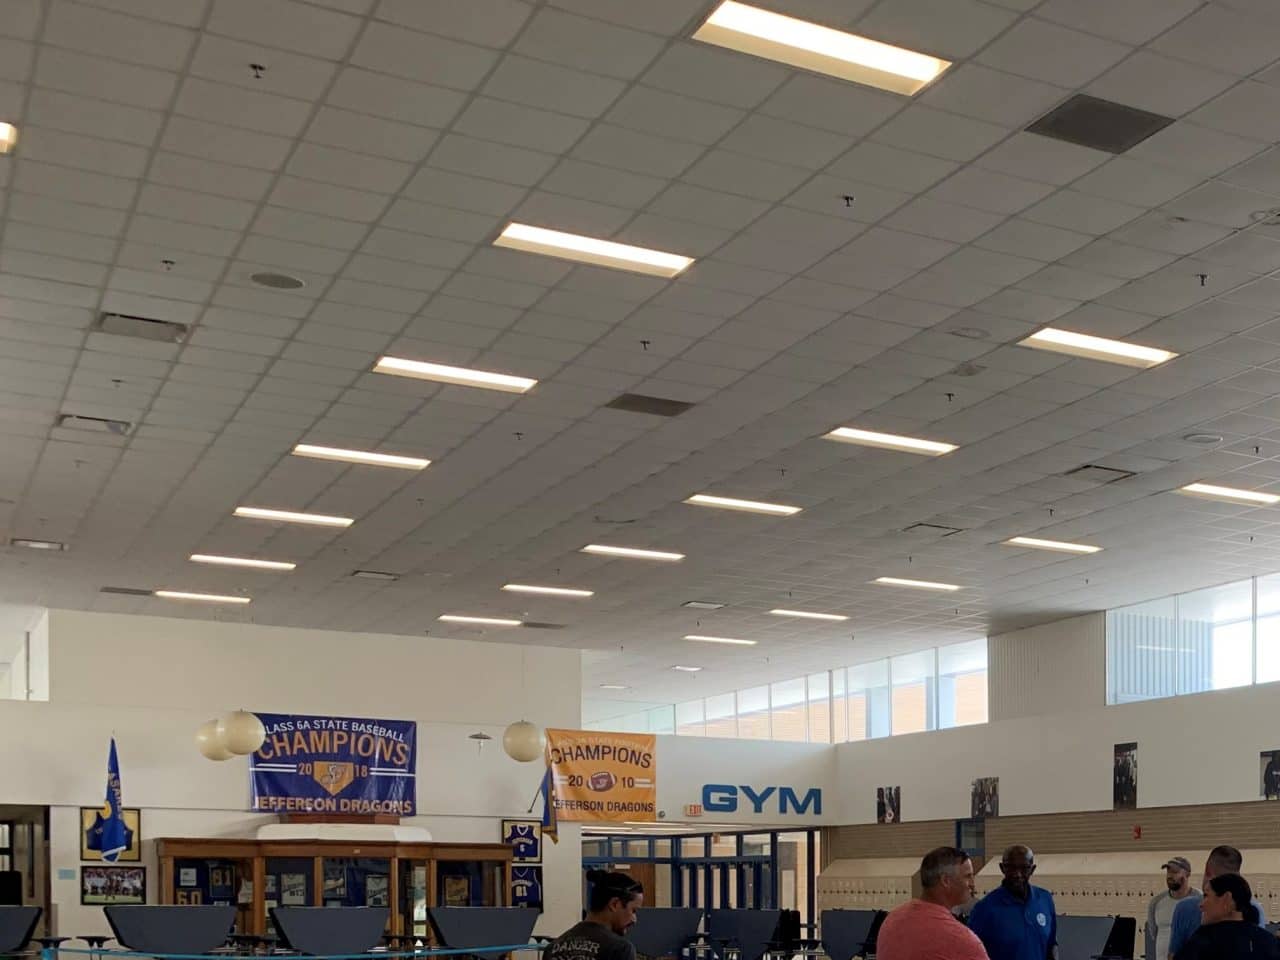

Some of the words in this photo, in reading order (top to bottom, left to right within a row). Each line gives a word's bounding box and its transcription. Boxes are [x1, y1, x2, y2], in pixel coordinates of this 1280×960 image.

[265, 721, 294, 734] LASS
[297, 720, 310, 729] 6A
[313, 719, 348, 730] STATE
[351, 722, 405, 743] BASEBALL
[258, 730, 410, 766] CHAMPIONS
[551, 744, 652, 768] CHAMPIONS
[298, 763, 312, 775] 20
[355, 766, 368, 777] 18
[568, 775, 583, 787] 20
[621, 777, 634, 788] 10
[253, 796, 337, 812] JEFFERSON
[340, 799, 413, 813] DRAGONS
[607, 800, 654, 812] DRAGONS
[702, 784, 822, 815] GYM
